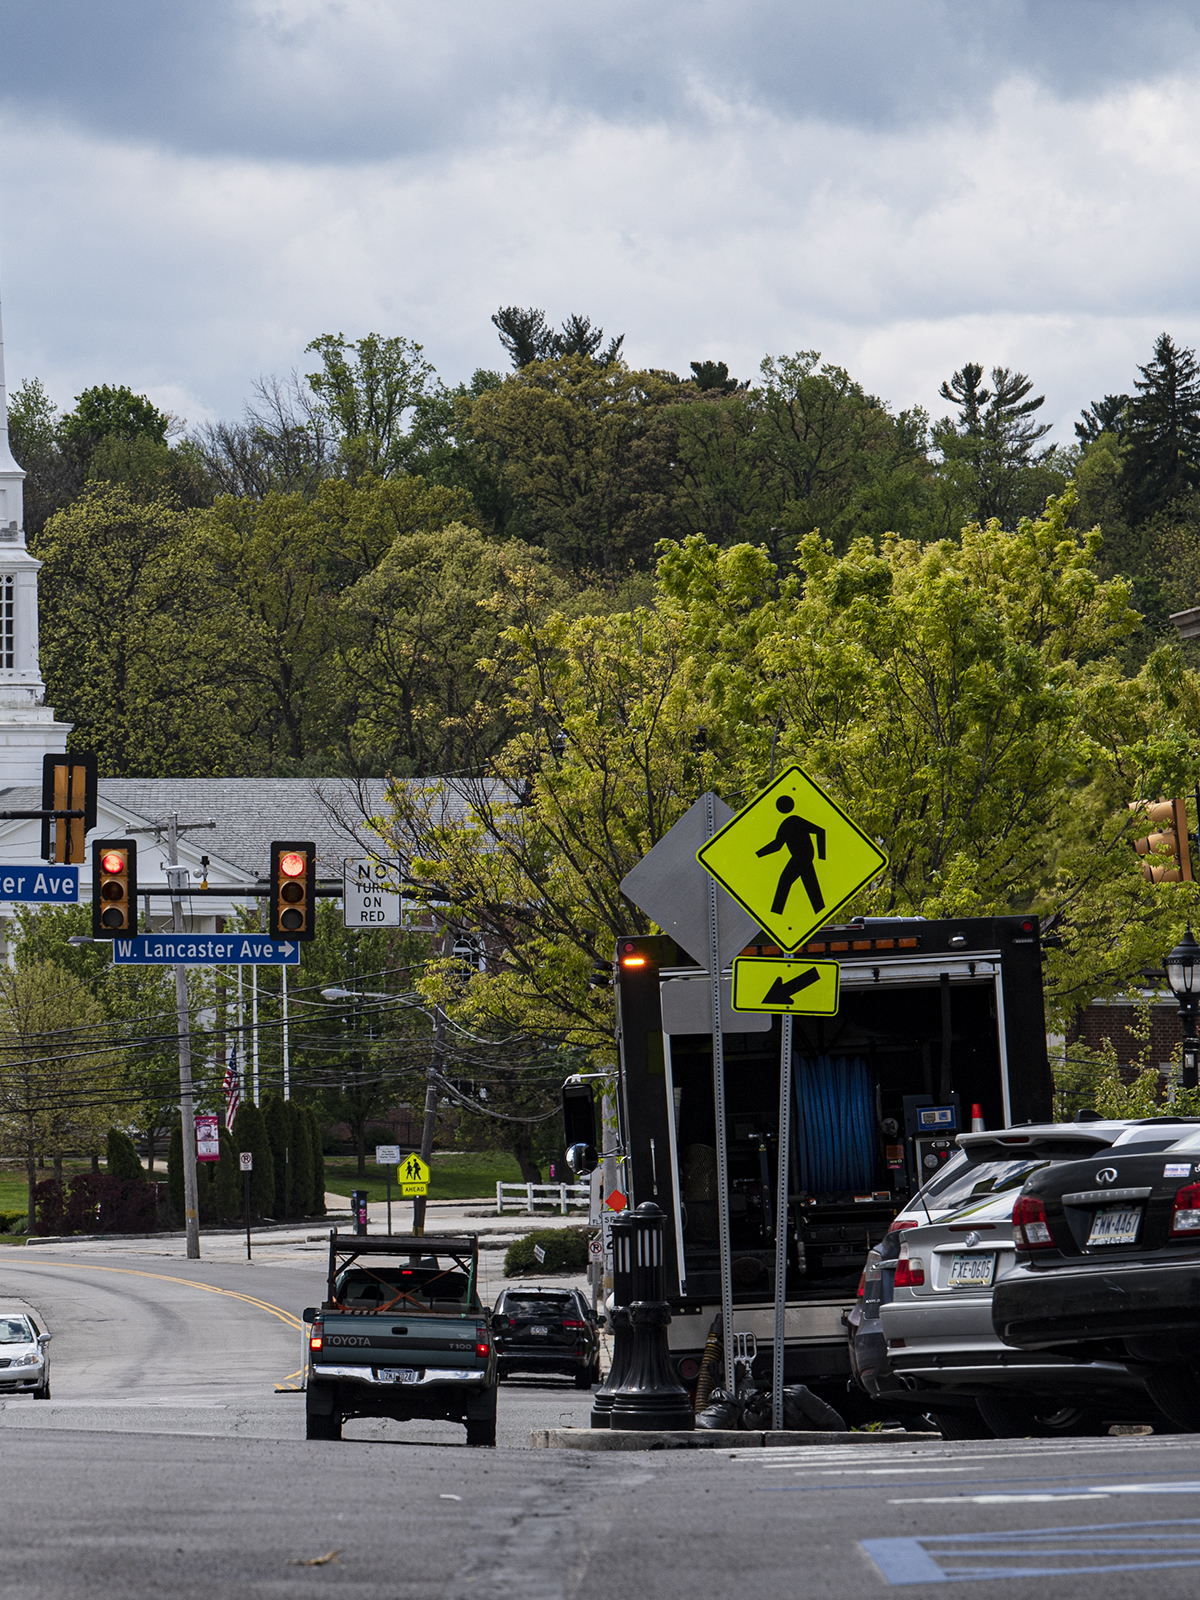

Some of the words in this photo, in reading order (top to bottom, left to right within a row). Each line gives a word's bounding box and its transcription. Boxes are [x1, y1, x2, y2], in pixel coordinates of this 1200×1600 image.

[358, 864, 387, 879] NO
[33, 873, 75, 895] Ave
[363, 896, 382, 908] ON
[360, 910, 386, 922] RED
[117, 940, 137, 958] W.
[144, 940, 234, 958] Lancaster
[239, 940, 274, 958] Ave
[951, 1260, 992, 1279] FXE-0605
[326, 1335, 372, 1346] TOYOTA
